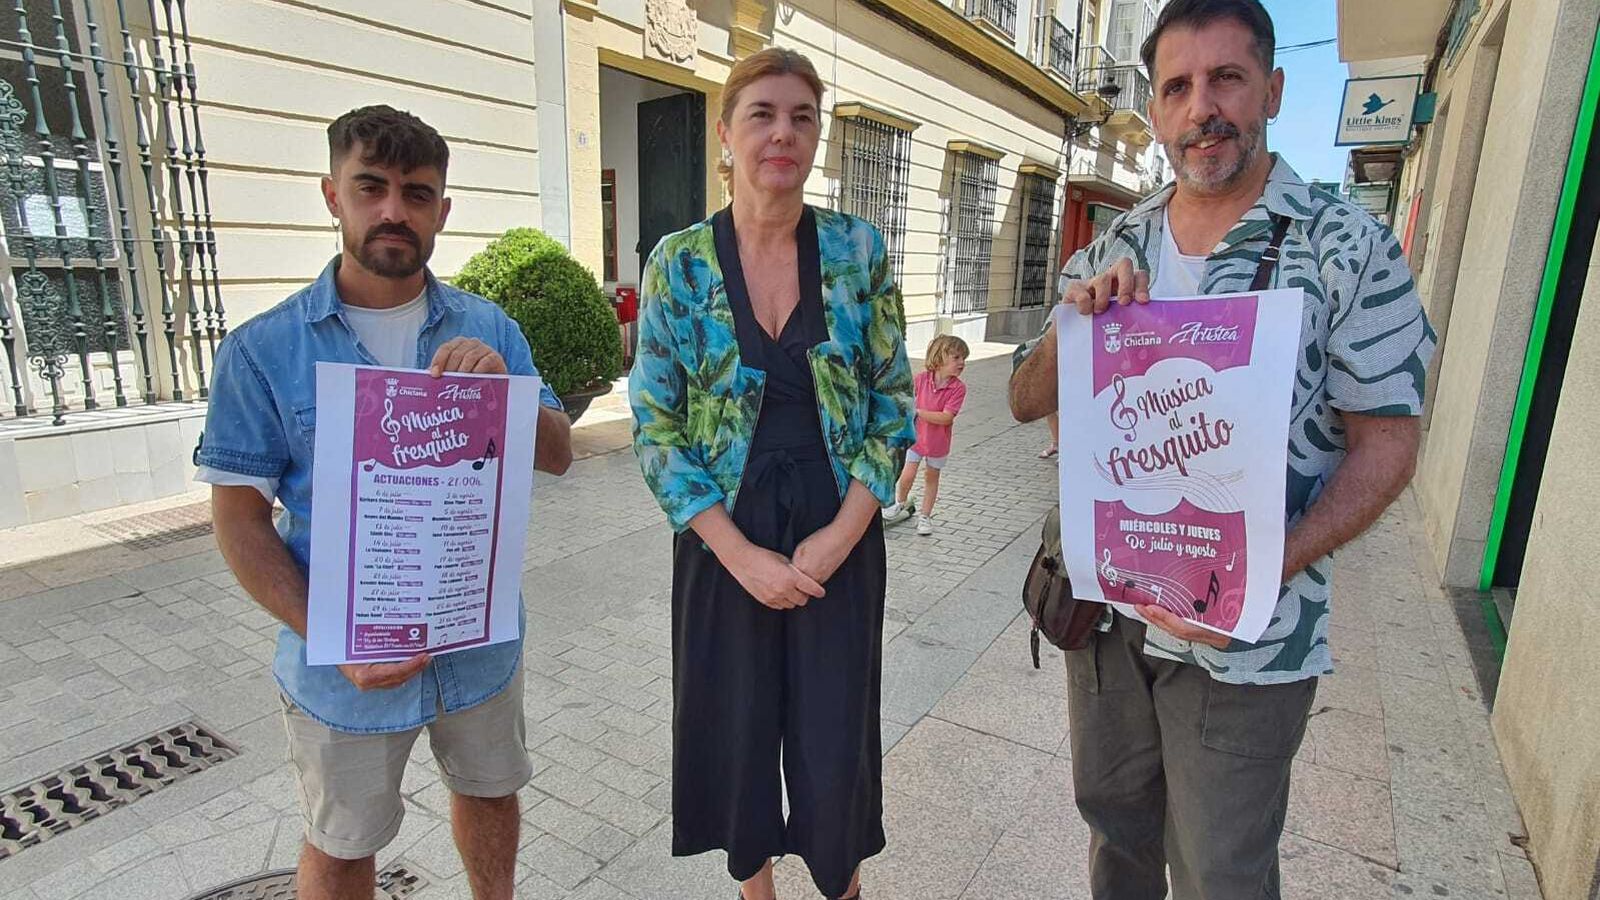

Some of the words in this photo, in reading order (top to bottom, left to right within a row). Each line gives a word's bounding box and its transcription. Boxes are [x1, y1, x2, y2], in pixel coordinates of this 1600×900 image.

[1346, 115, 1372, 126] Little
[1124, 335, 1162, 348] Chiclana
[399, 388, 428, 398] Chiclana
[1136, 376, 1214, 420] Música
[401, 405, 464, 433] Música
[1168, 410, 1183, 431] al
[431, 427, 442, 440] al
[391, 428, 470, 466] fresquito
[1107, 411, 1235, 486] fresquito
[373, 473, 439, 487] ACTUACIONES
[1119, 519, 1177, 535] MIÉRCOLES
[1178, 524, 1186, 536] Y
[1186, 525, 1222, 542] JUEVES
[1125, 533, 1147, 550] De
[1149, 536, 1174, 553] julio
[1175, 544, 1183, 557] y
[1185, 544, 1218, 559] agosto
